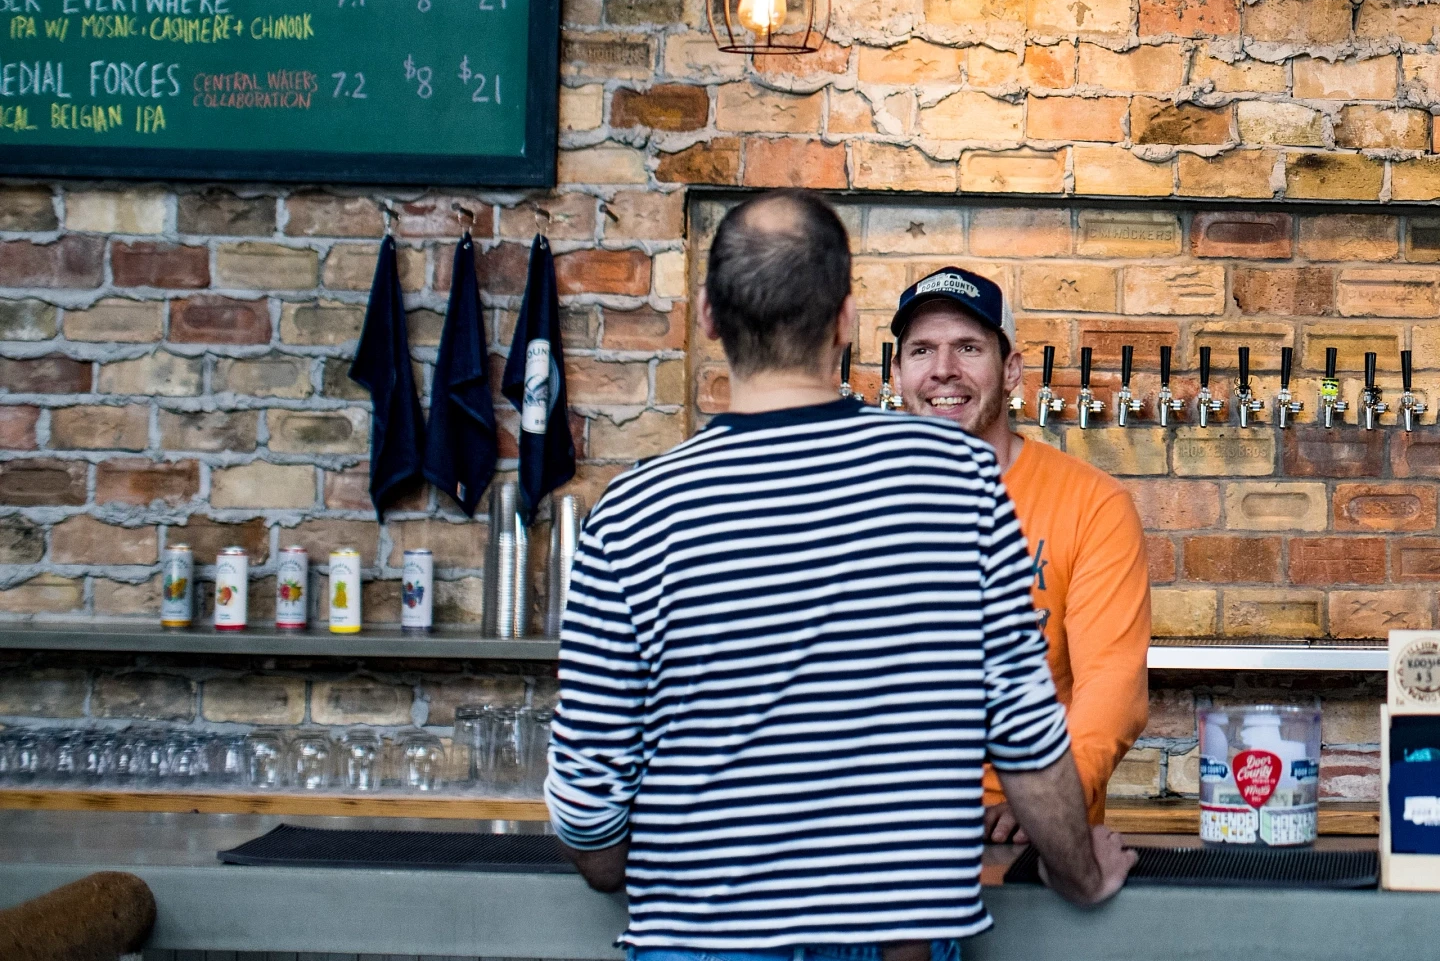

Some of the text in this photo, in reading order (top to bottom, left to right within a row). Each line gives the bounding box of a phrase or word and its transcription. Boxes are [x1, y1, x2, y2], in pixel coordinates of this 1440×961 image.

[10, 14, 38, 40] IPA
[251, 13, 314, 40] CHINOOK
[0, 60, 72, 99] EDIAL
[90, 60, 181, 99] FORCES
[193, 71, 261, 92] CENTRAL
[267, 69, 318, 93] WATERS
[331, 72, 368, 99] 7.2
[192, 92, 312, 110] COLLABORATION
[51, 102, 167, 134] BELGIAN IPA
[943, 280, 975, 293] COUNTY
